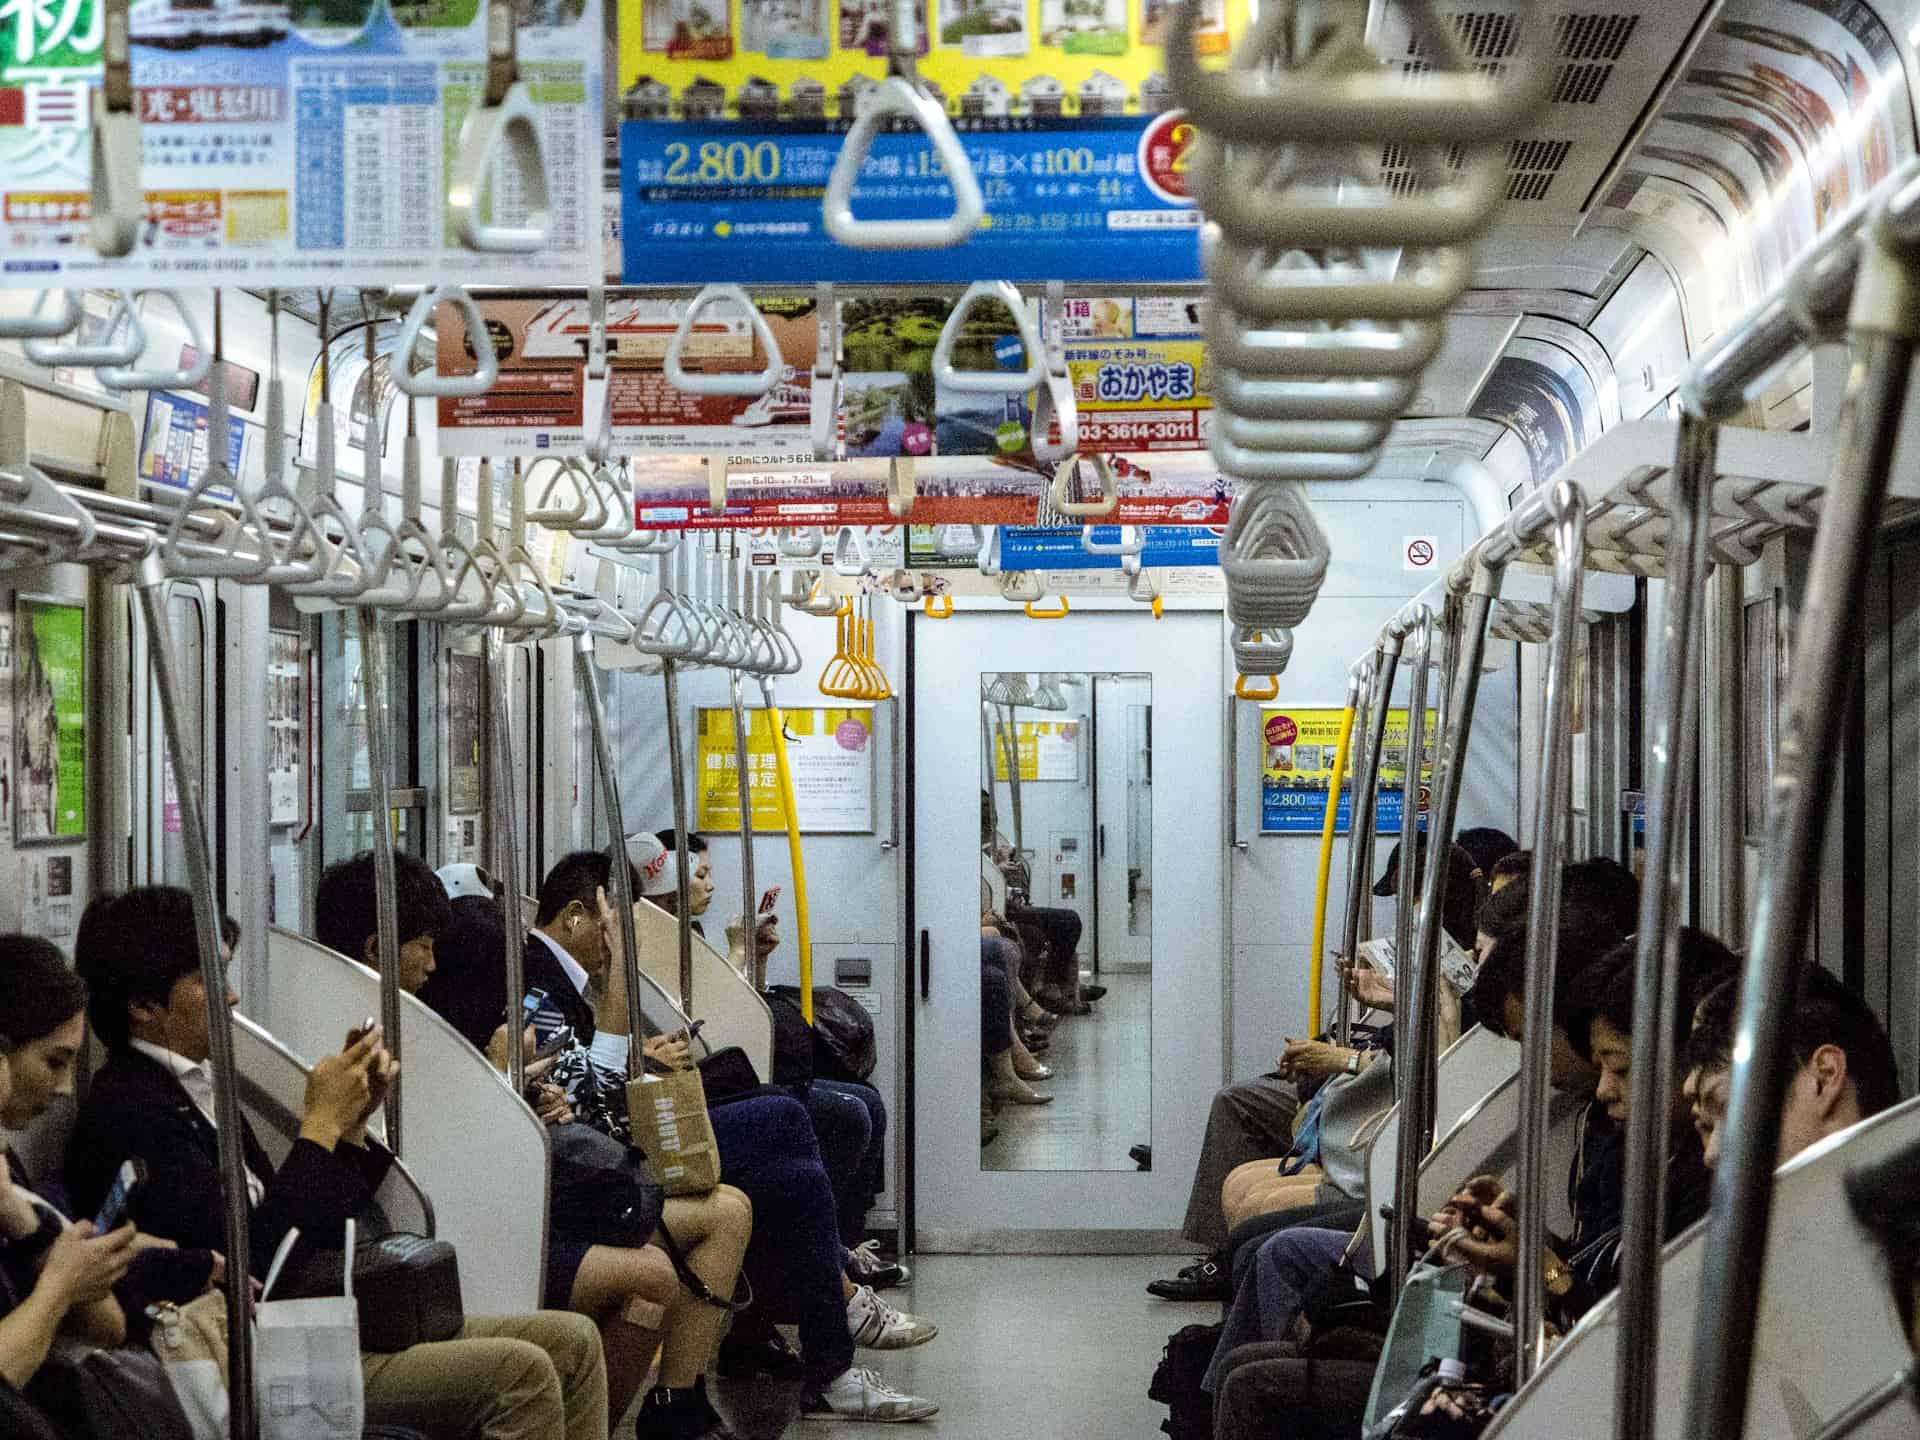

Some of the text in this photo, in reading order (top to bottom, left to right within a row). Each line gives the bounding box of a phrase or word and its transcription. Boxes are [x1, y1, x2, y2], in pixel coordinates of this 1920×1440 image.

[144, 88, 279, 121] 光・鬼怒川
[1100, 364, 1190, 397] おかやま
